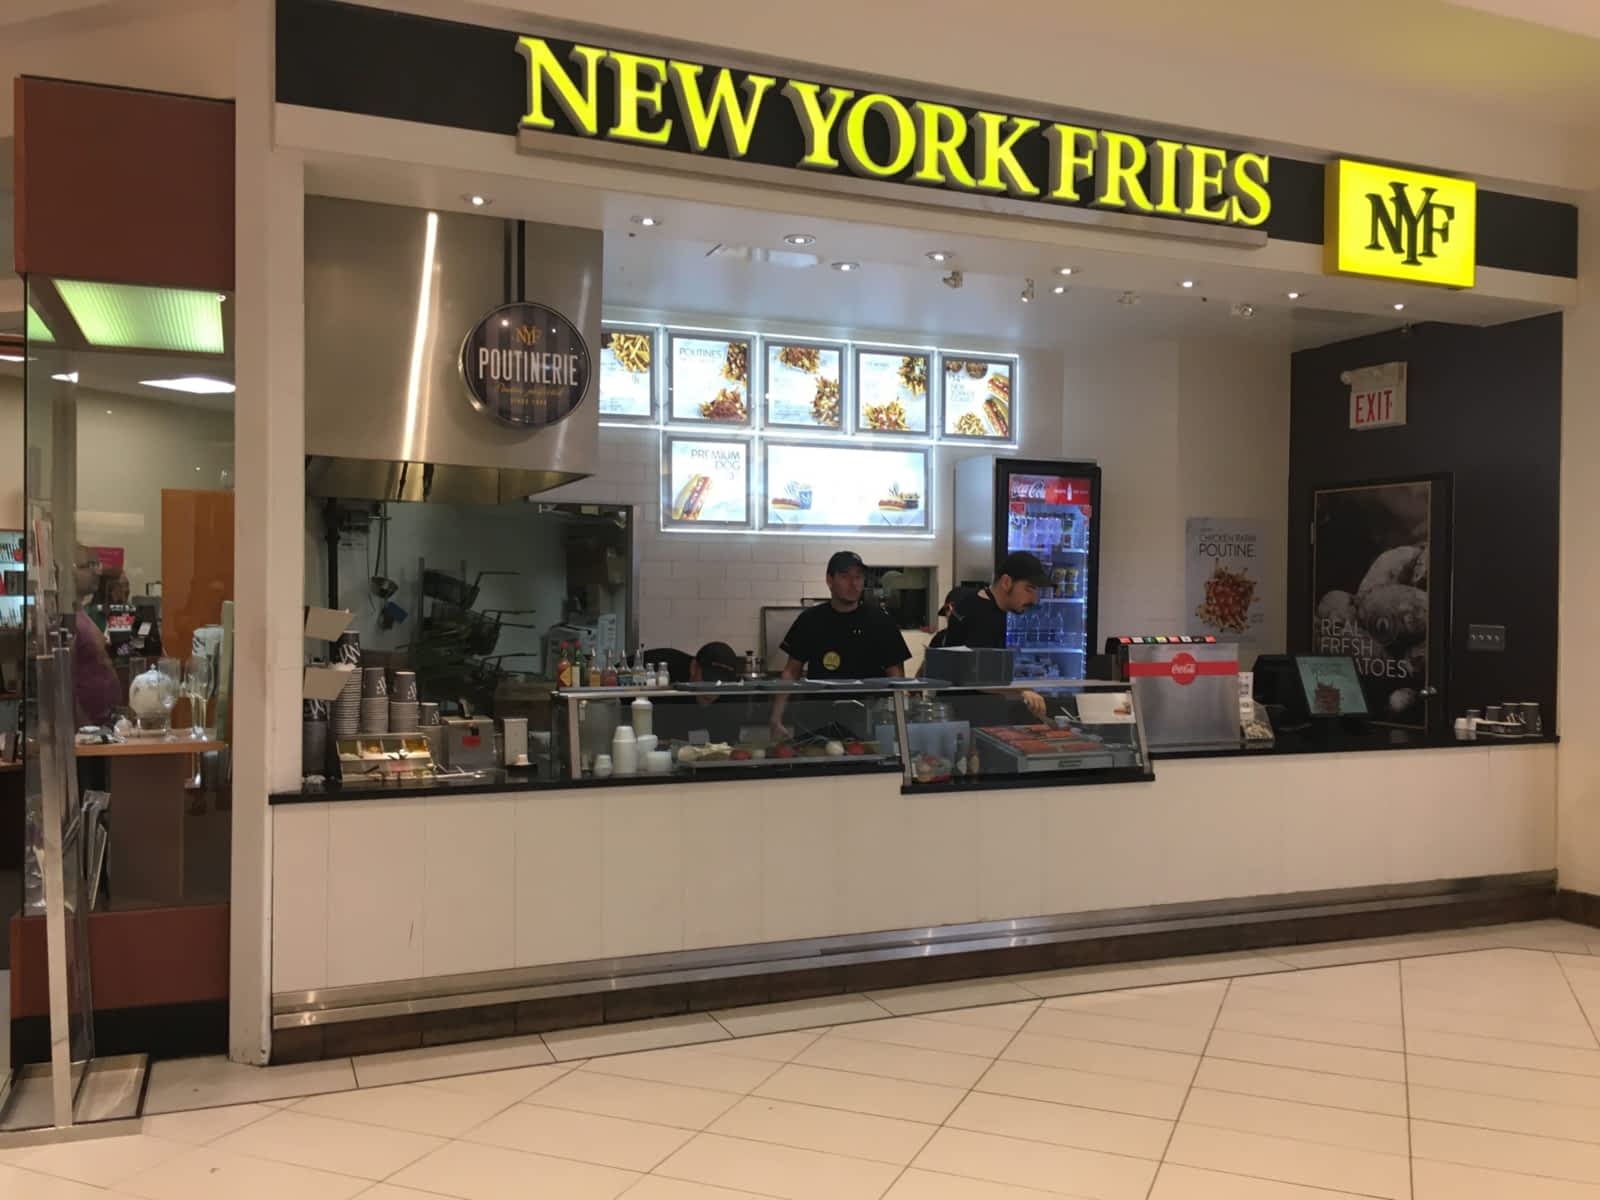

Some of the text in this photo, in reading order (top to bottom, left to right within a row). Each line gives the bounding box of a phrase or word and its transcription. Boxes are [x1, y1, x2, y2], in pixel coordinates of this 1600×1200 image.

[515, 36, 1271, 226] NEW YORK FRIES
[1364, 181, 1456, 266] NYF
[478, 347, 579, 386] POUTINERIE
[1355, 390, 1393, 424] EXIT
[1199, 543, 1257, 558] POUTINE
[1320, 617, 1361, 637] REAL
[1320, 636, 1374, 657] FRESH
